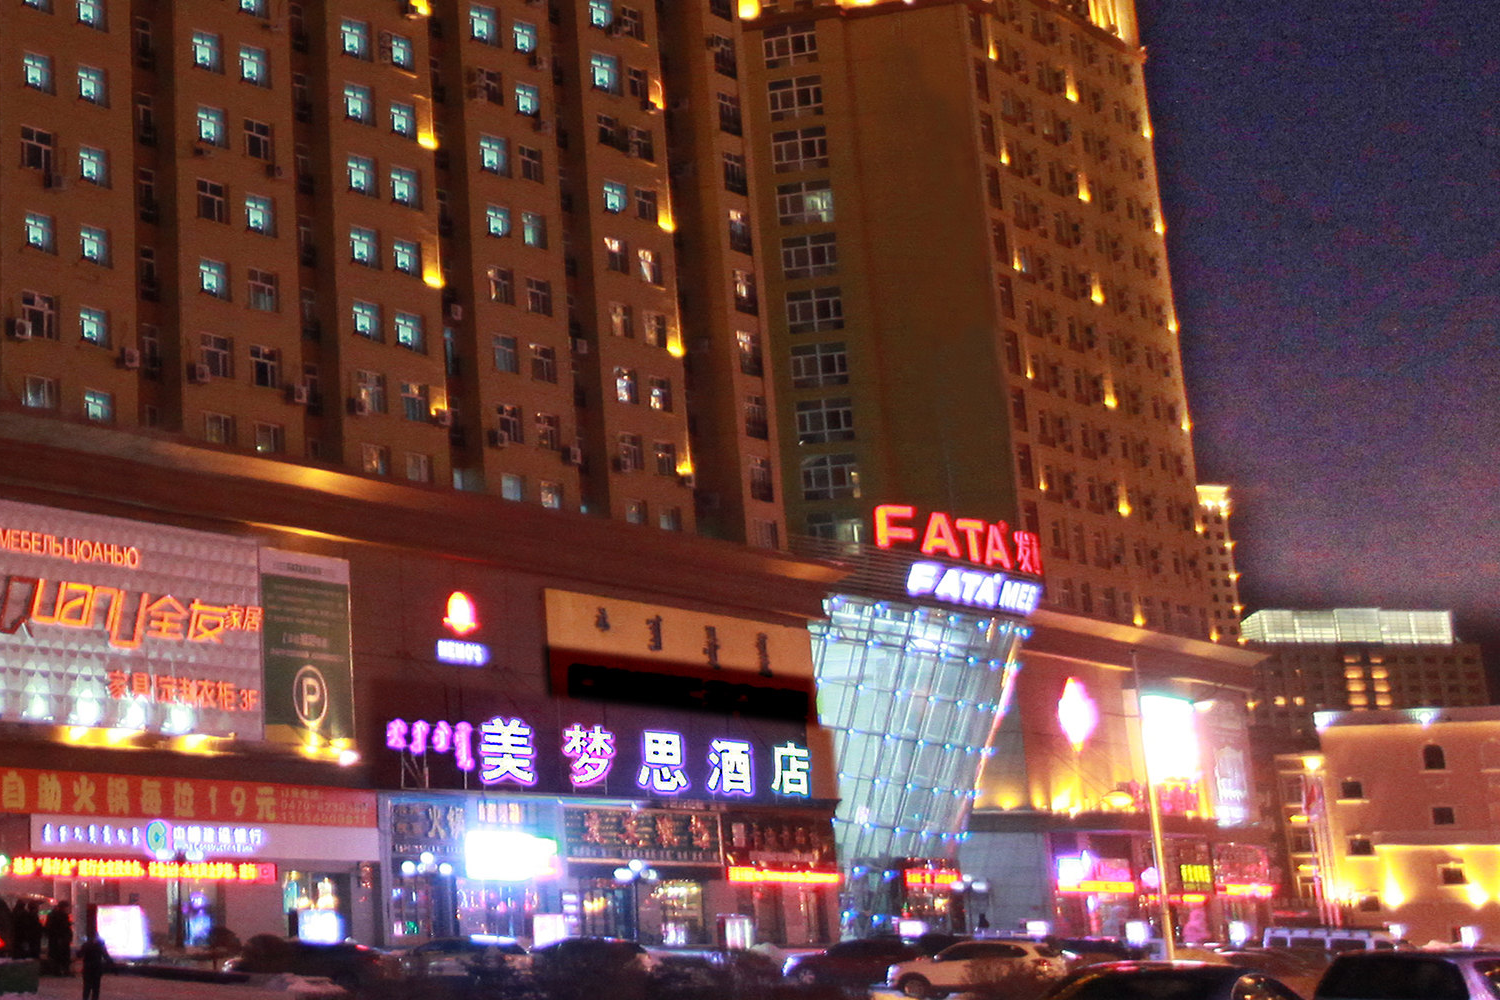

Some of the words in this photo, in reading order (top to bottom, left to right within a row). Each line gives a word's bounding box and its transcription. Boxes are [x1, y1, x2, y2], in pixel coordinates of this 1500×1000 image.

[874, 505, 1013, 569] FATA
[480, 717, 809, 794] 美梦思酒店
